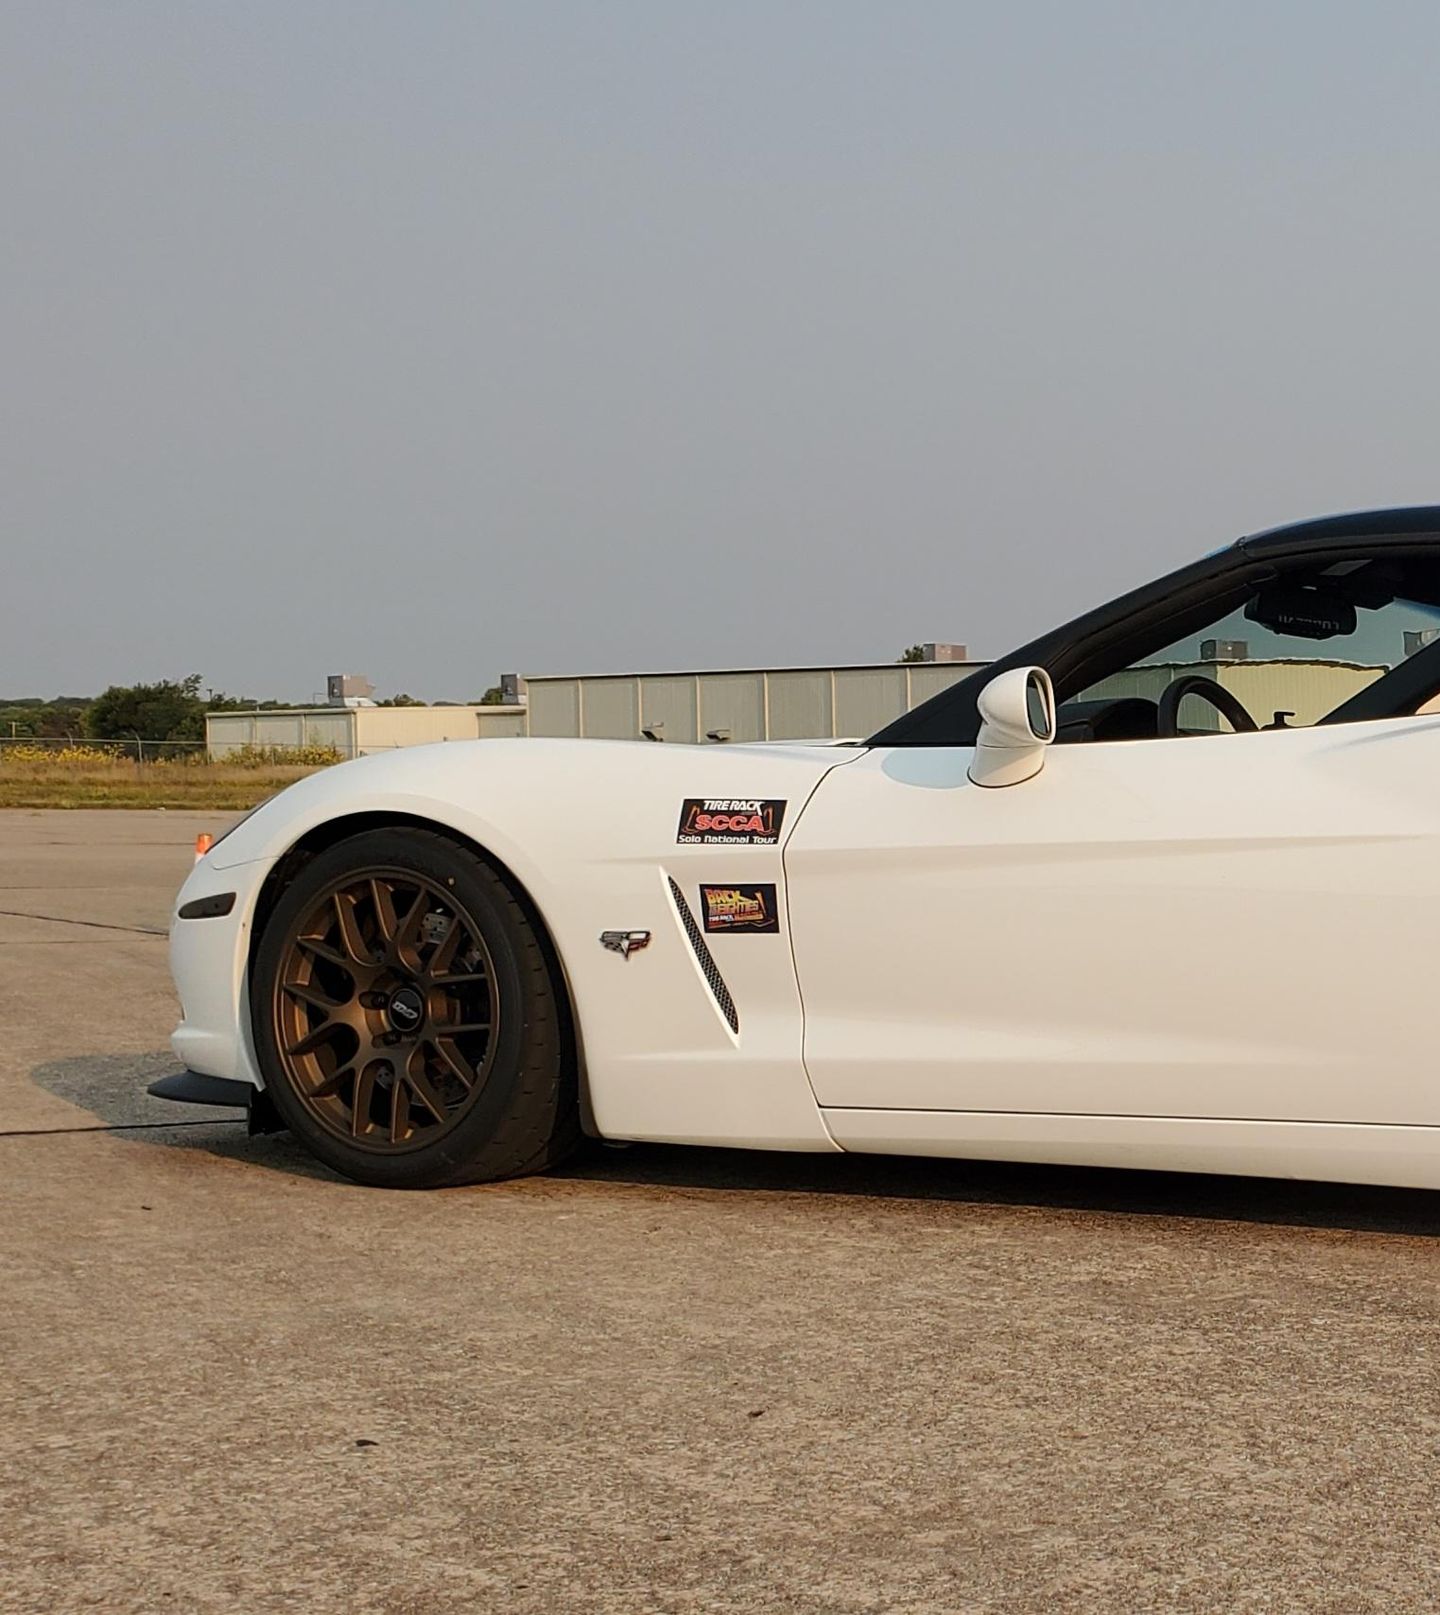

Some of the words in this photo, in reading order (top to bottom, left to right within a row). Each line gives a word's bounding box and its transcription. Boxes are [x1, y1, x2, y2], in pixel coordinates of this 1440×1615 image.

[695, 814, 764, 831] SCCA
[679, 834, 702, 843] Solo
[752, 835, 777, 844] Tour
